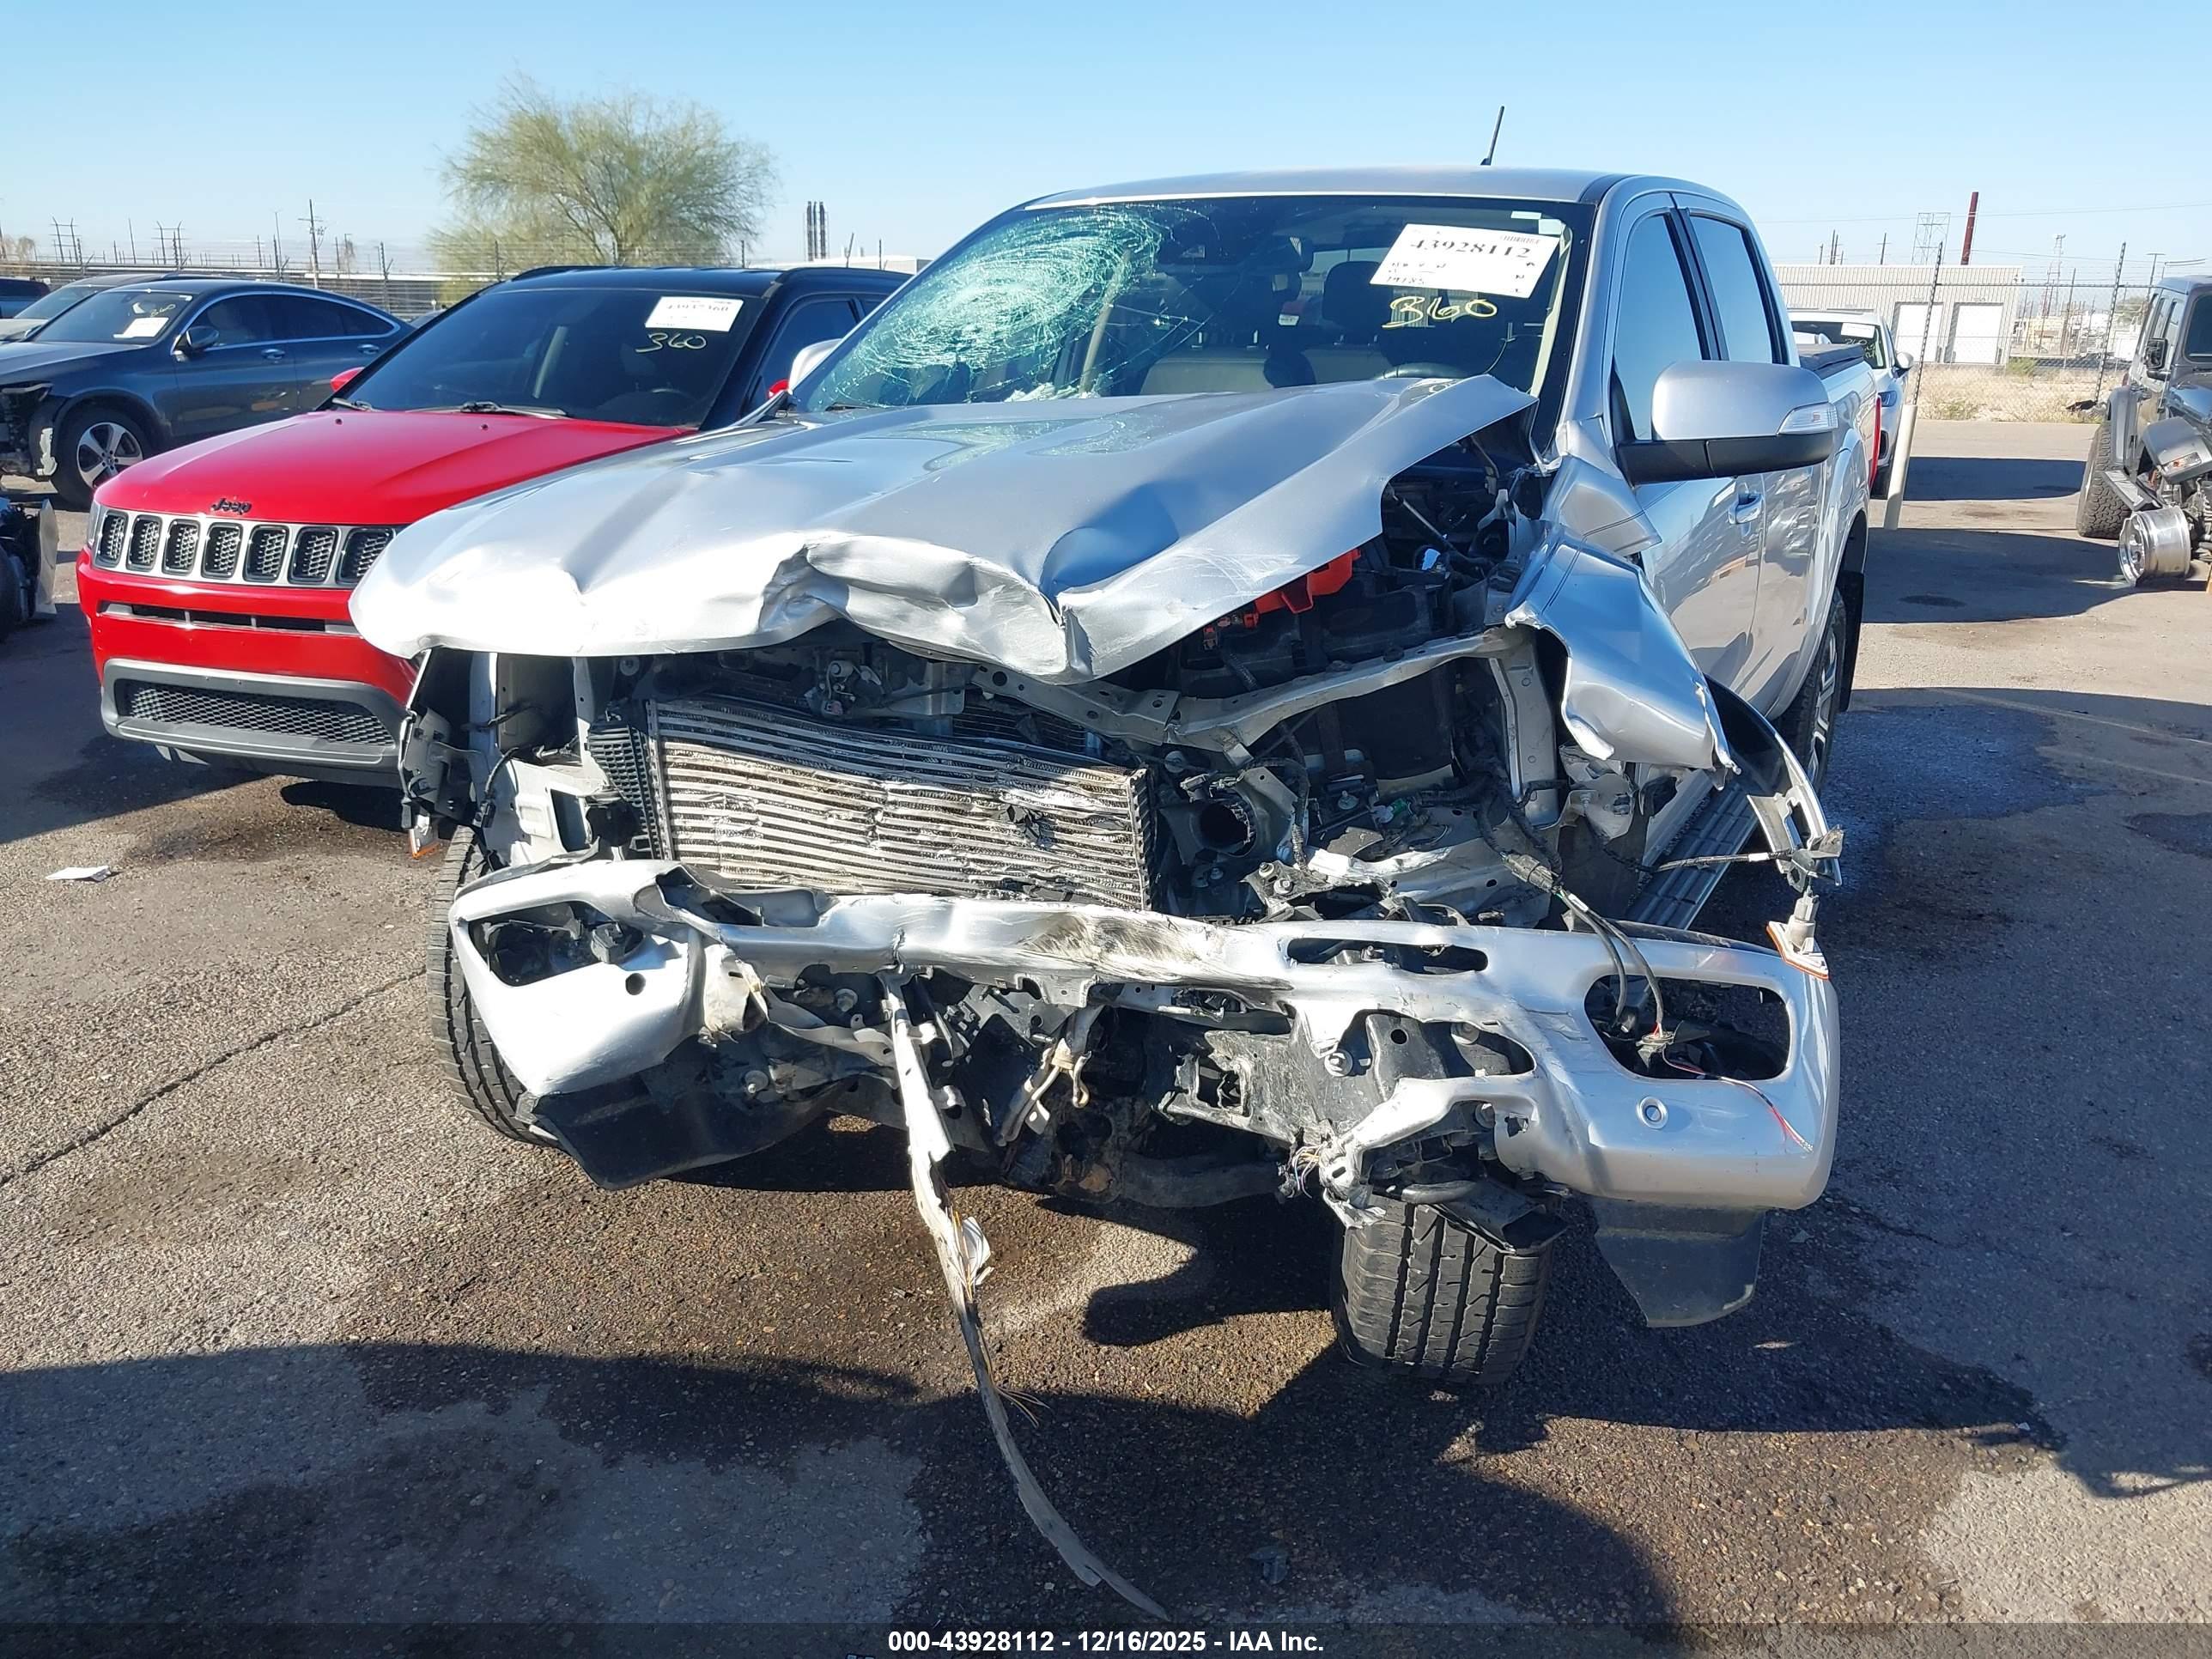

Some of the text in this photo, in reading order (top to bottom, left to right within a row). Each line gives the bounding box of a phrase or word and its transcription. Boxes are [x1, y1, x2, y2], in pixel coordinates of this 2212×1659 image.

[1410, 239, 1531, 258] 43928112
[635, 332, 707, 352] 360
[211, 497, 252, 515] Jeep
